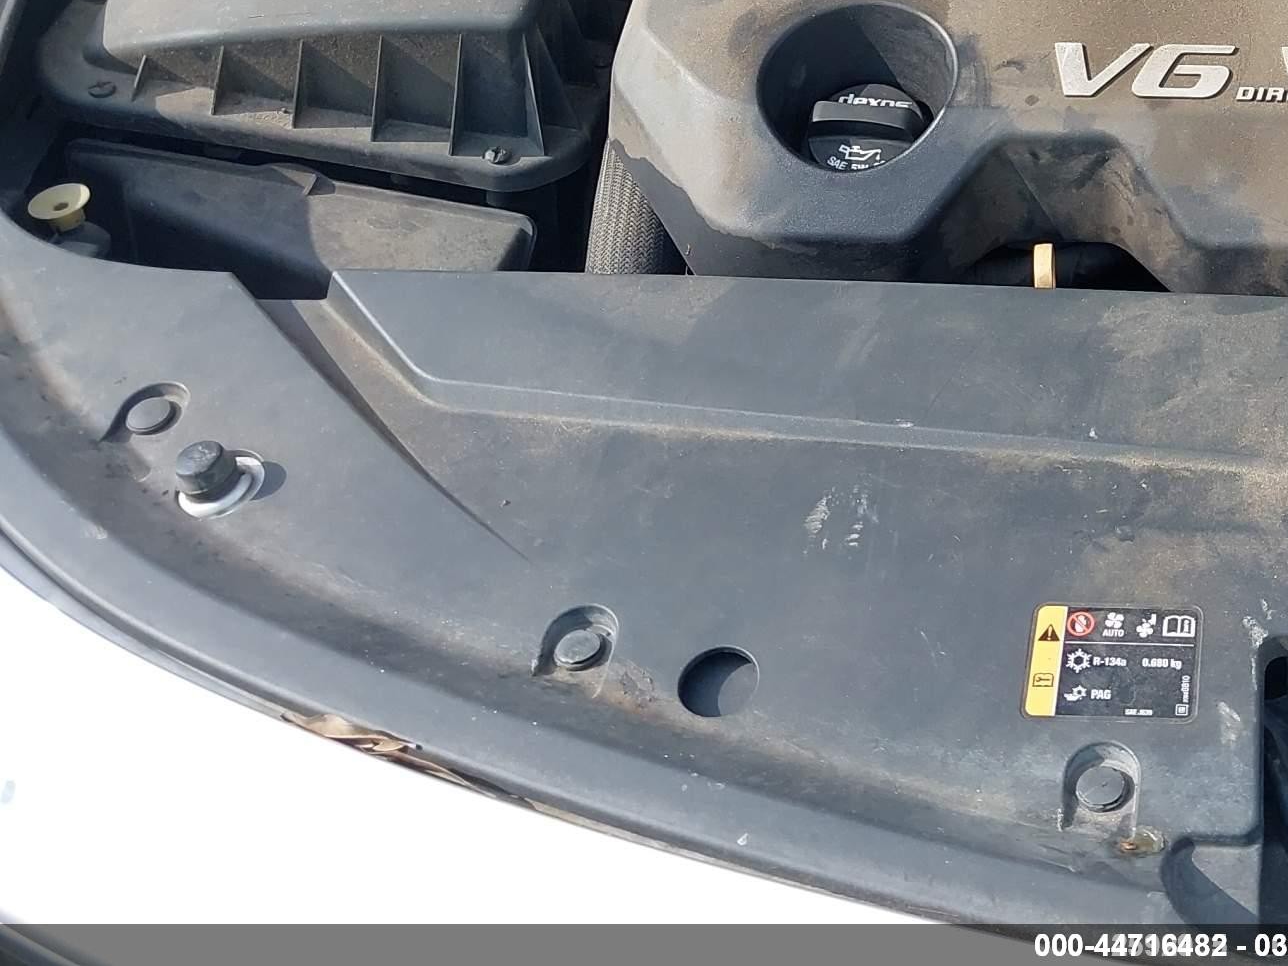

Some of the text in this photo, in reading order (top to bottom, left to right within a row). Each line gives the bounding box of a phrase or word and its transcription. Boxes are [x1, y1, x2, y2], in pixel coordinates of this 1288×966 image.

[1054, 42, 1236, 99] V6
[827, 156, 848, 170] SAE
[1102, 630, 1125, 638] AUTO
[1093, 656, 1127, 667] R-134a
[1090, 689, 1112, 700] PAG
